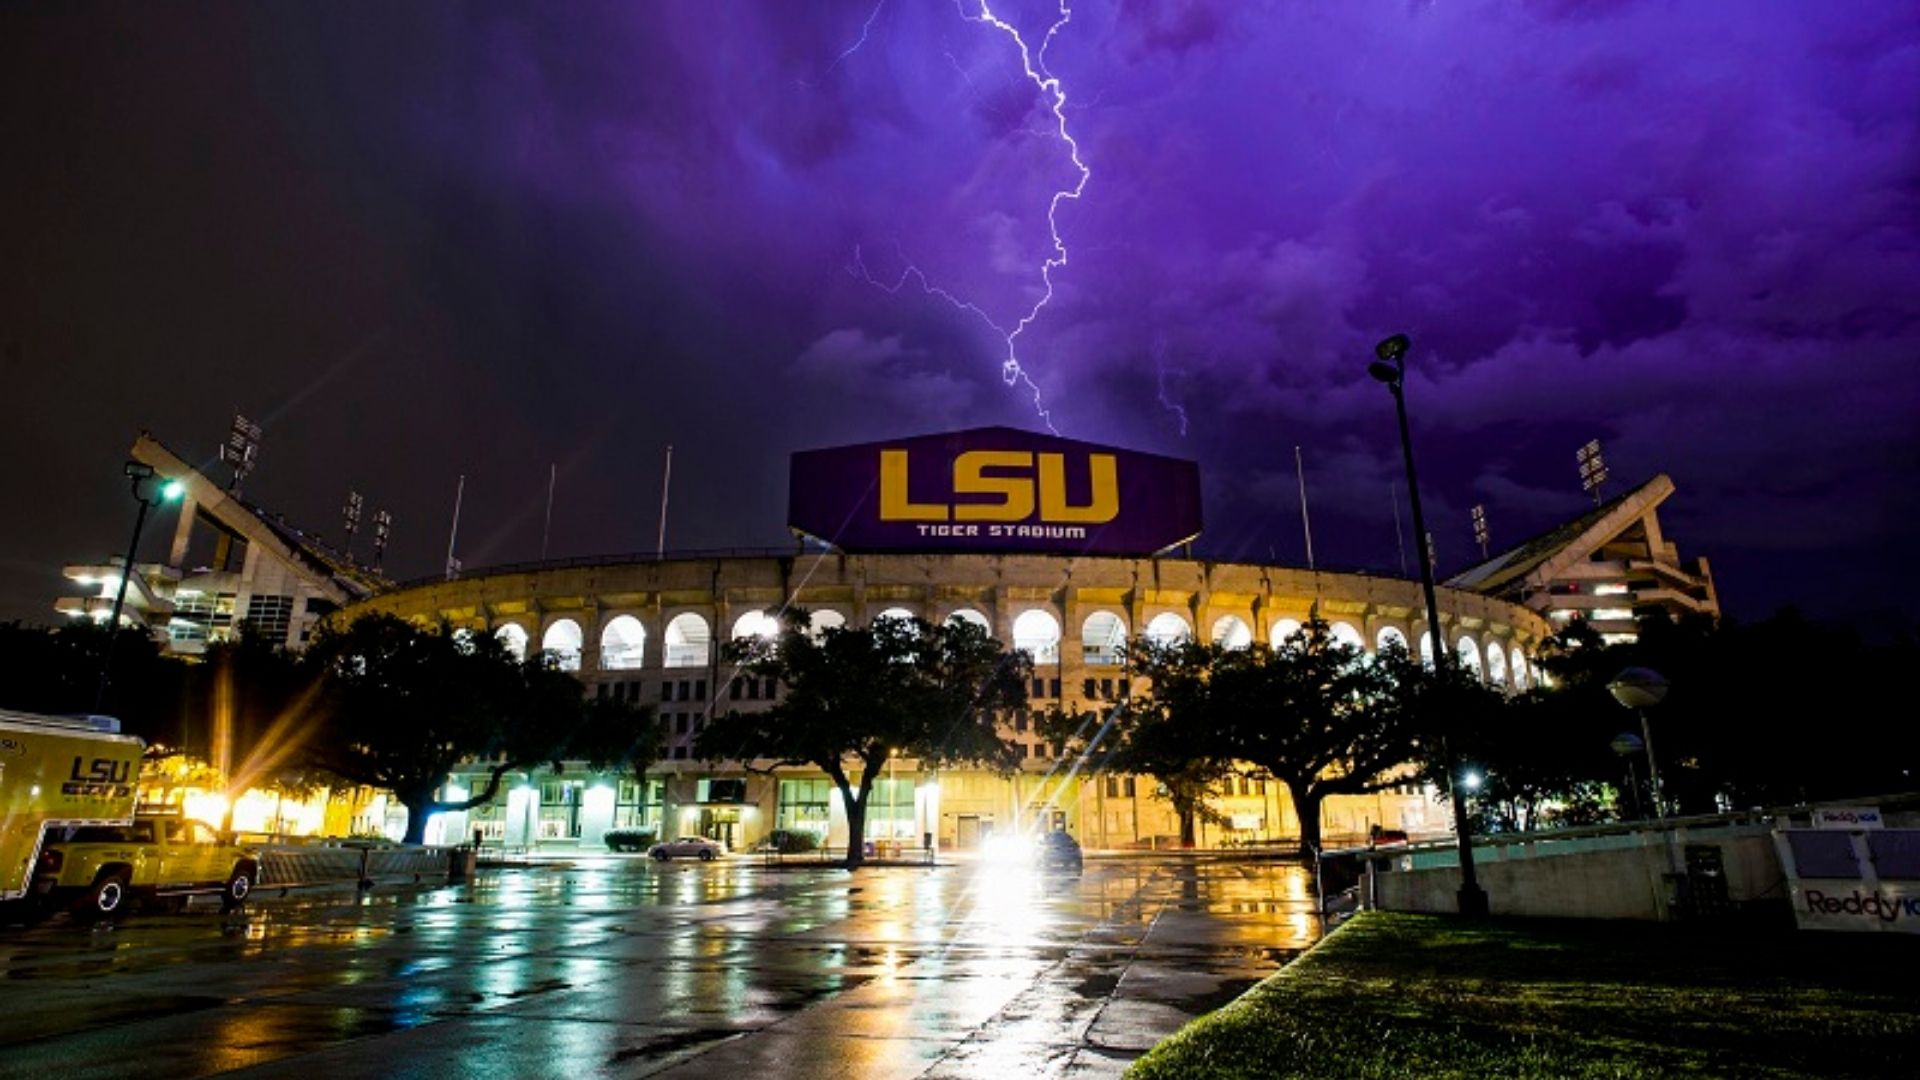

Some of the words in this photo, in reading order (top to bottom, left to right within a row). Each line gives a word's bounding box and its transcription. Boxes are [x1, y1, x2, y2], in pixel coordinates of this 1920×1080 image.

[880, 450, 1119, 523] LSU
[917, 525, 978, 536] TIGER
[989, 525, 1086, 538] STADIUM
[71, 756, 130, 783] LSU
[1805, 889, 1900, 922] Reddy
